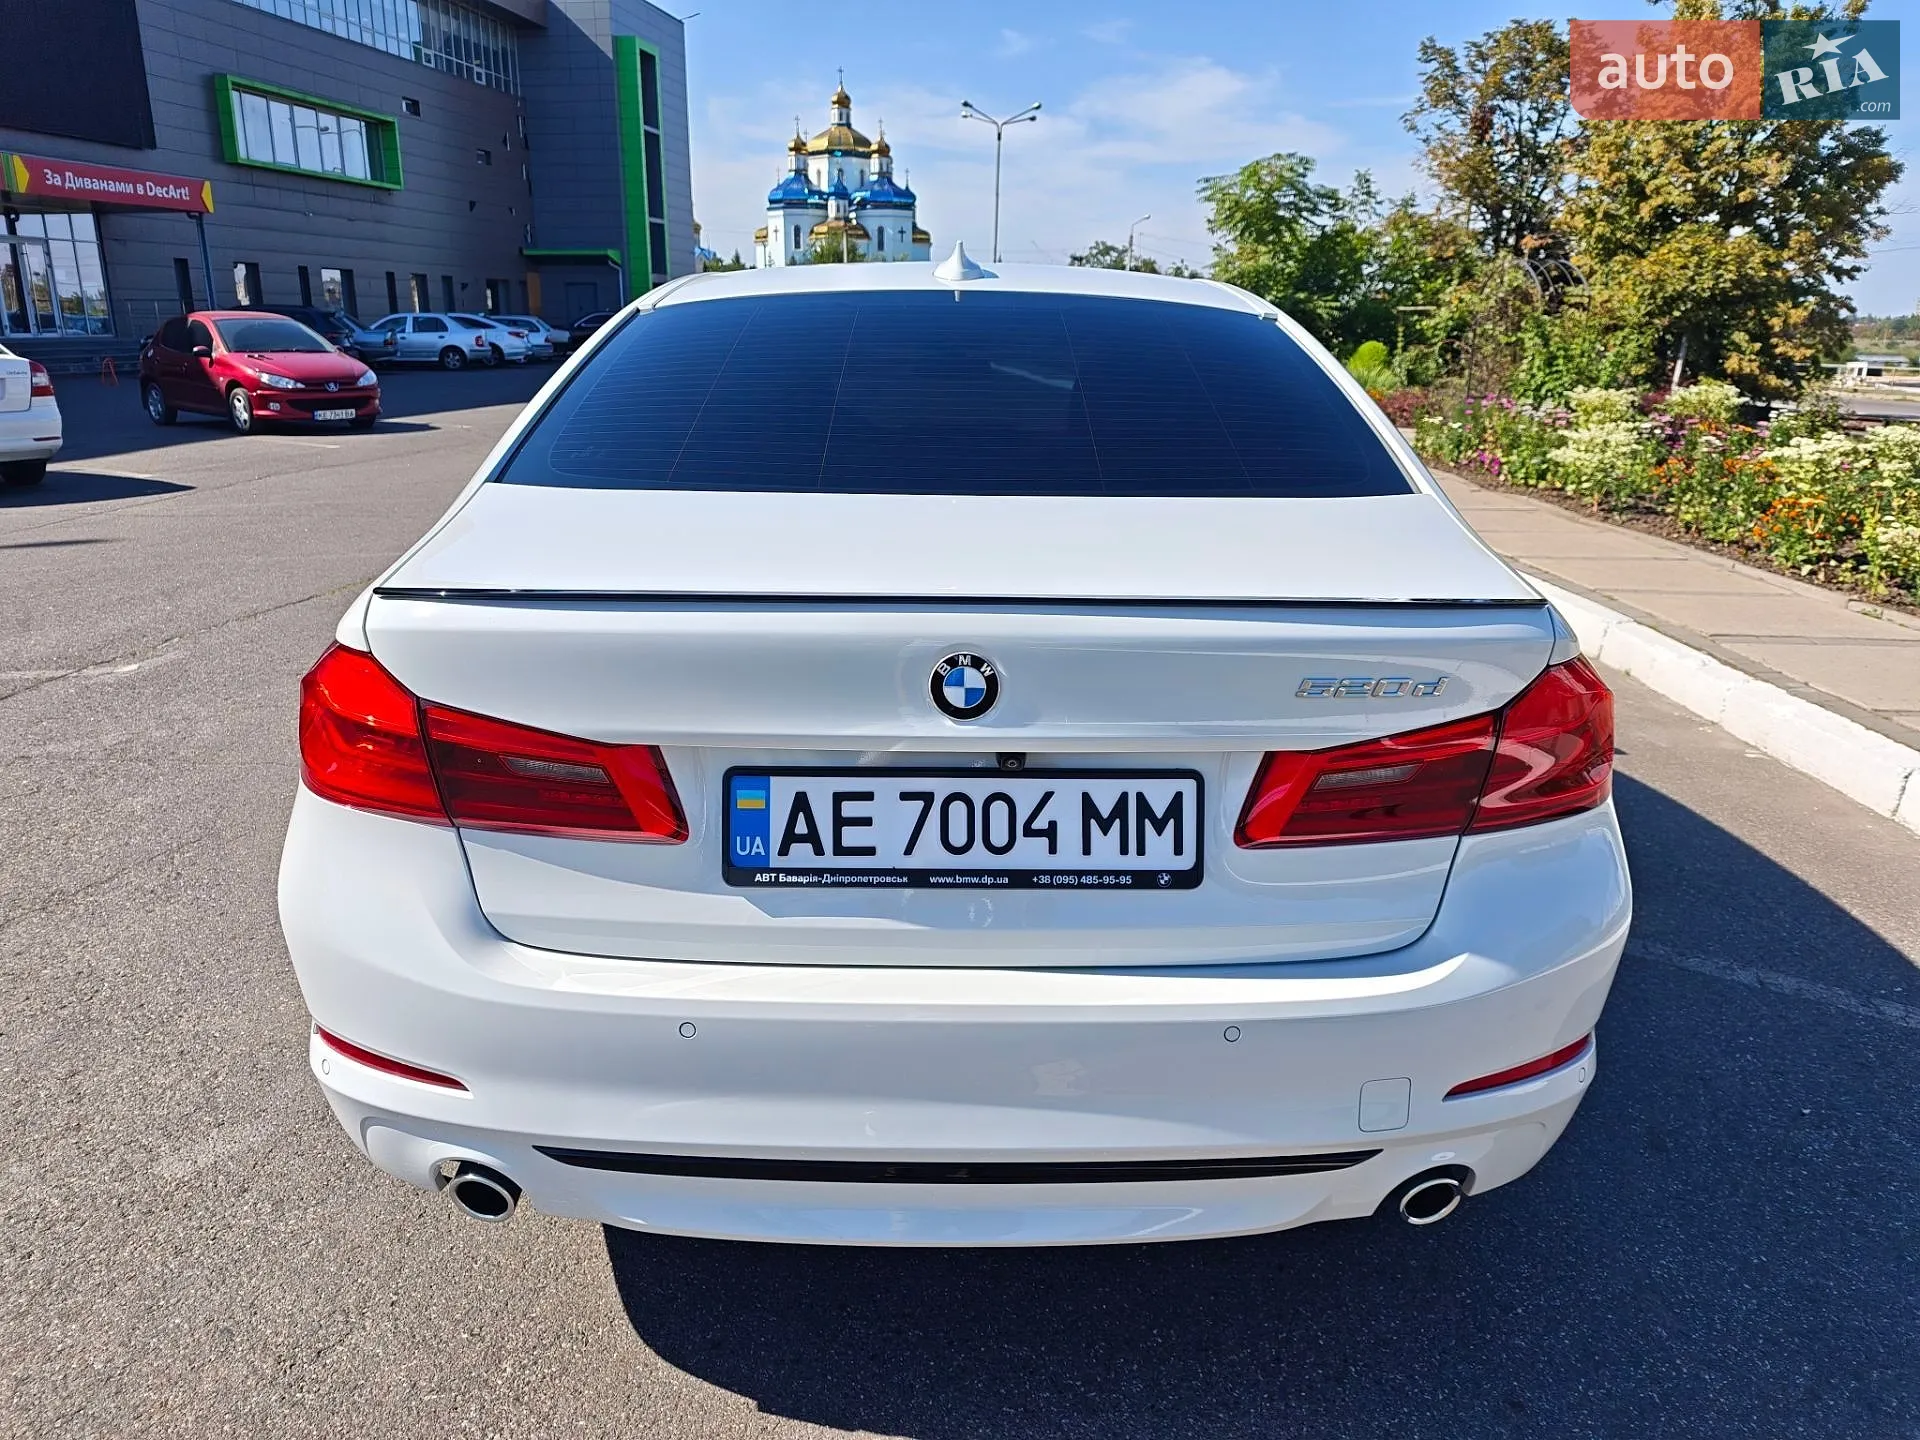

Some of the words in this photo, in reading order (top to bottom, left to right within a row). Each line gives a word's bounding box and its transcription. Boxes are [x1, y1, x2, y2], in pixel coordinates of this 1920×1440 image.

[43, 168, 62, 186] За
[65, 172, 134, 194] Диванами
[137, 185, 144, 195] в
[146, 182, 190, 200] DecArt!
[936, 654, 995, 677] BMW
[1295, 676, 1449, 698] 520d
[777, 790, 877, 857] AE
[899, 790, 1058, 857] 7004
[1081, 790, 1184, 857] MM
[736, 836, 765, 856] UA
[754, 873, 776, 882] АВТ
[778, 873, 908, 885] Баварія-Дніпропетровськ
[929, 874, 1009, 886] www.bmw.dp.ua
[1032, 874, 1050, 884] +38
[1052, 874, 1078, 886] (095)
[1080, 874, 1132, 885] 485-95-95
